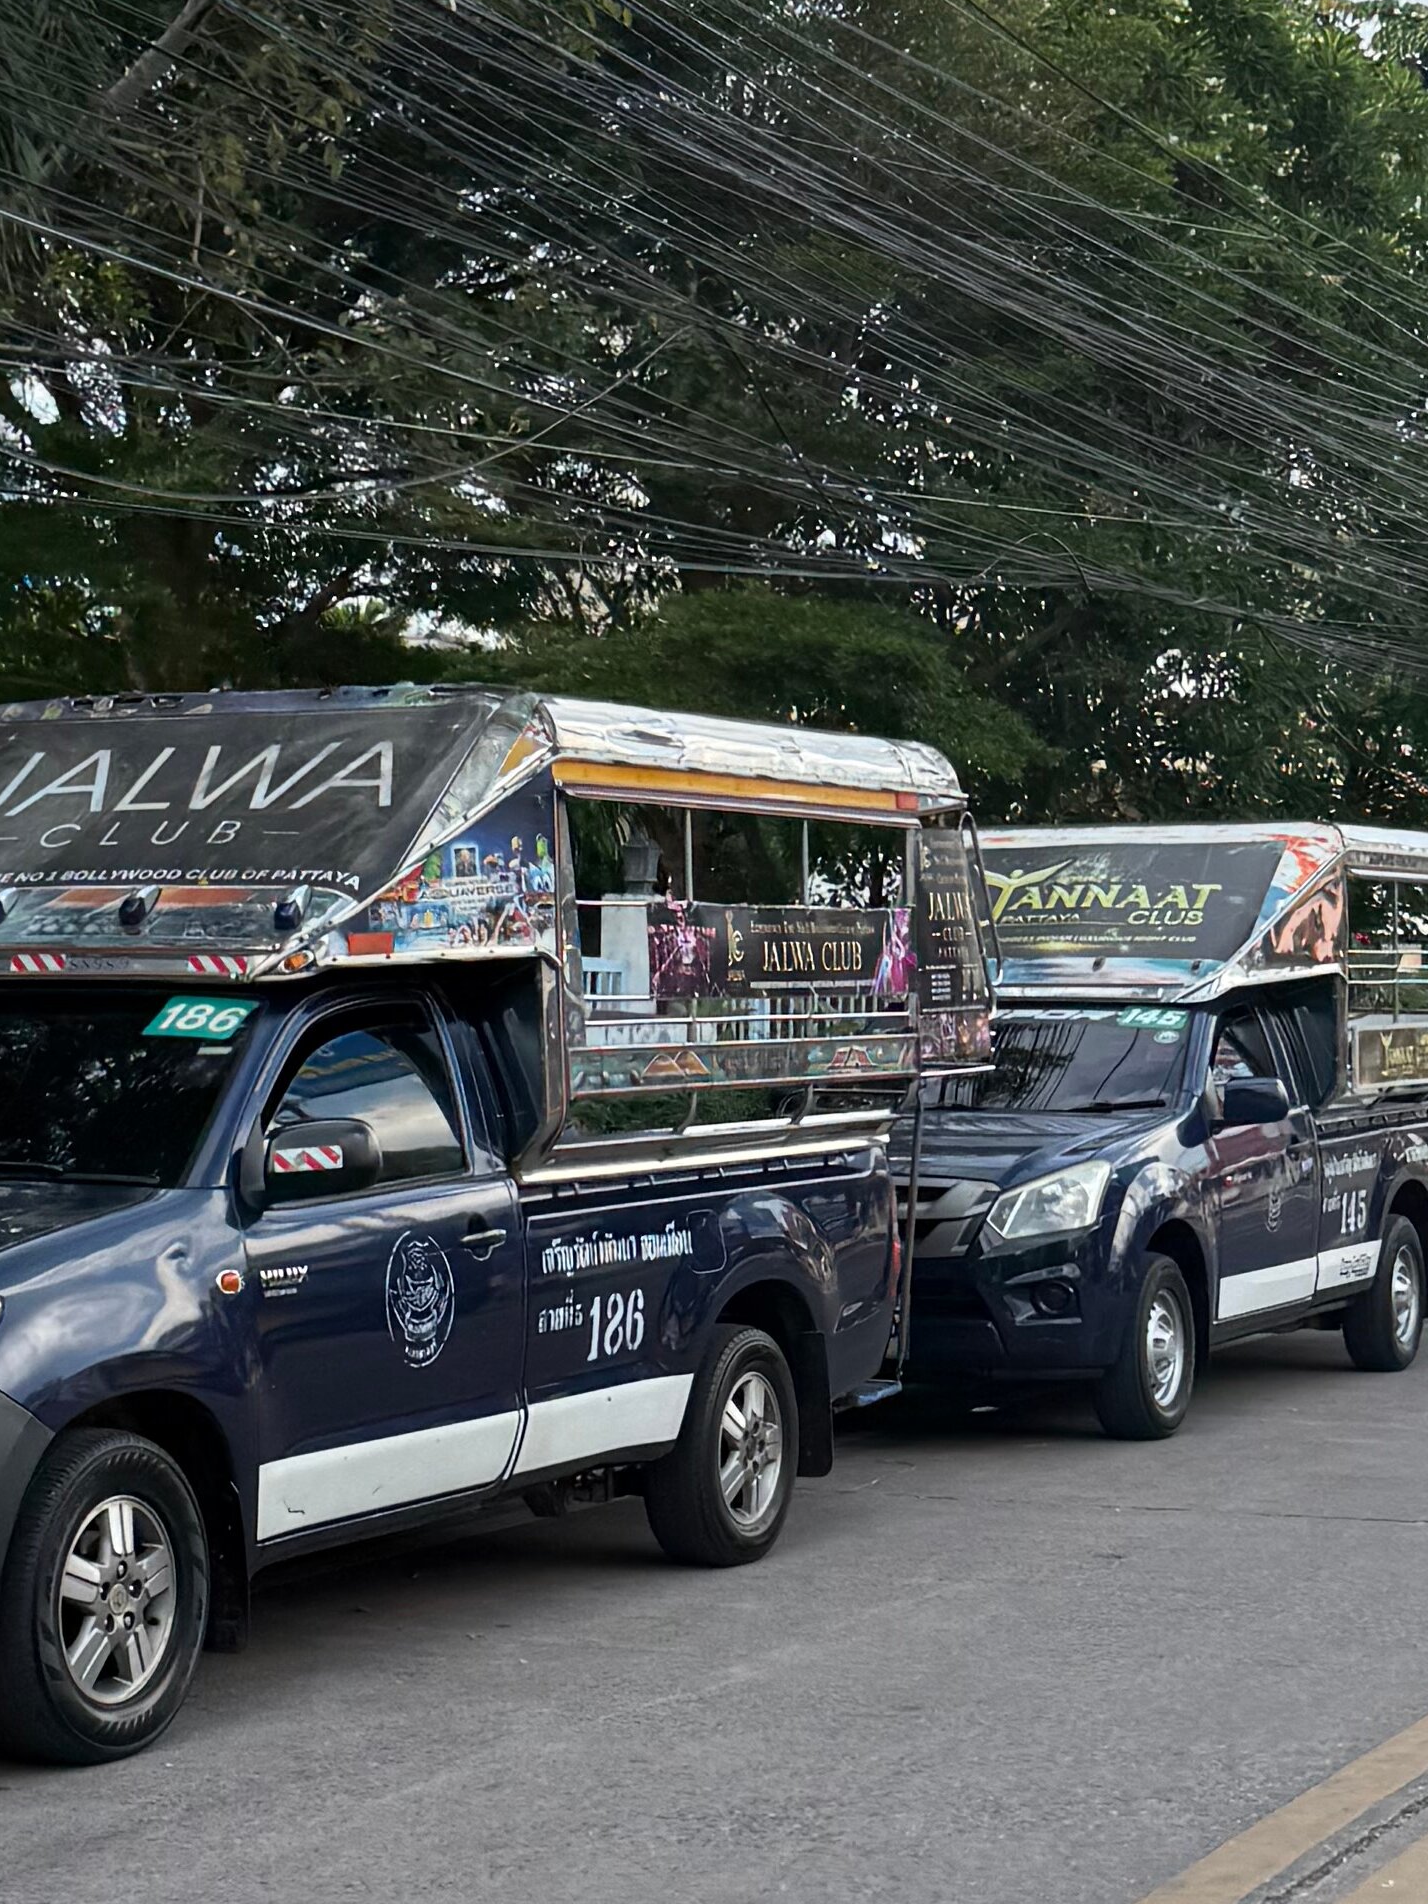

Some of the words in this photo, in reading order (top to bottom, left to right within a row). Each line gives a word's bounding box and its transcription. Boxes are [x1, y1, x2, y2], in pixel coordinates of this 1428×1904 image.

[39, 819, 242, 848] CLUB
[59, 868, 182, 882] BOLLYWOOD
[185, 868, 236, 881] CLUB
[241, 868, 269, 880] OF
[271, 869, 360, 891] PATTAYA
[1127, 910, 1204, 926] CLUB
[762, 940, 816, 972] JALWA
[822, 940, 863, 972] CLUB
[158, 1002, 248, 1033] 186
[1122, 1007, 1180, 1026] 145
[1340, 1189, 1368, 1235] 145
[586, 1288, 645, 1362] 186
